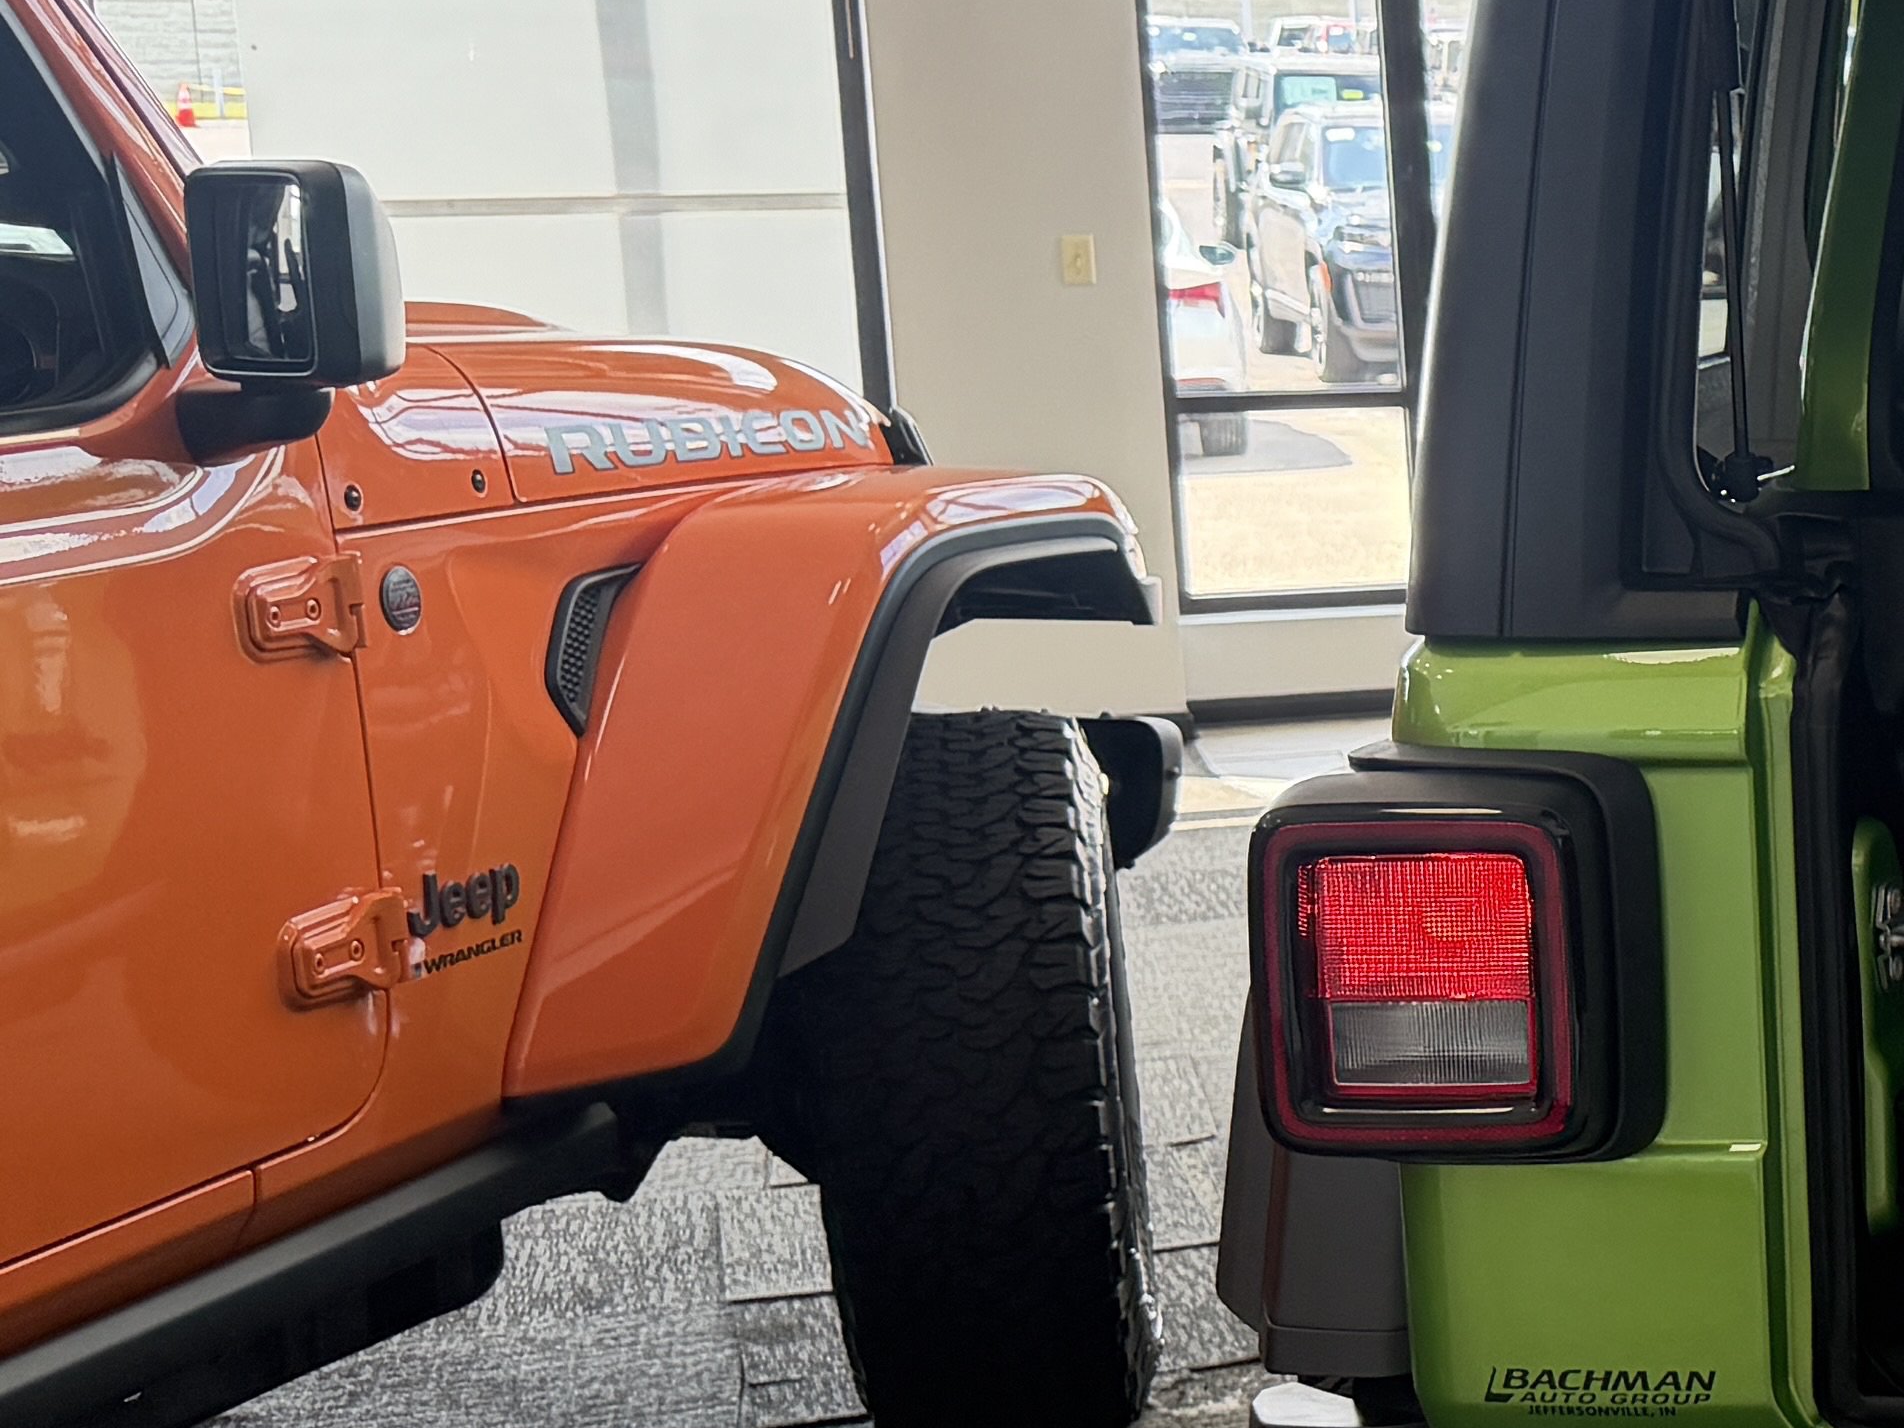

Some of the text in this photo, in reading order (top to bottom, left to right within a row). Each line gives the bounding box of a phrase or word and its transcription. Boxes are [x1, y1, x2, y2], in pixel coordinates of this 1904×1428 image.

[544, 409, 871, 476] RUBICON
[406, 862, 520, 937] Jeep
[422, 929, 523, 974] WRANGLER
[1502, 1368, 1717, 1391] BACHMAN
[1519, 1391, 1712, 1405] AUTO GROUP
[1527, 1405, 1677, 1417] JEFFERSONVILLE, IN
